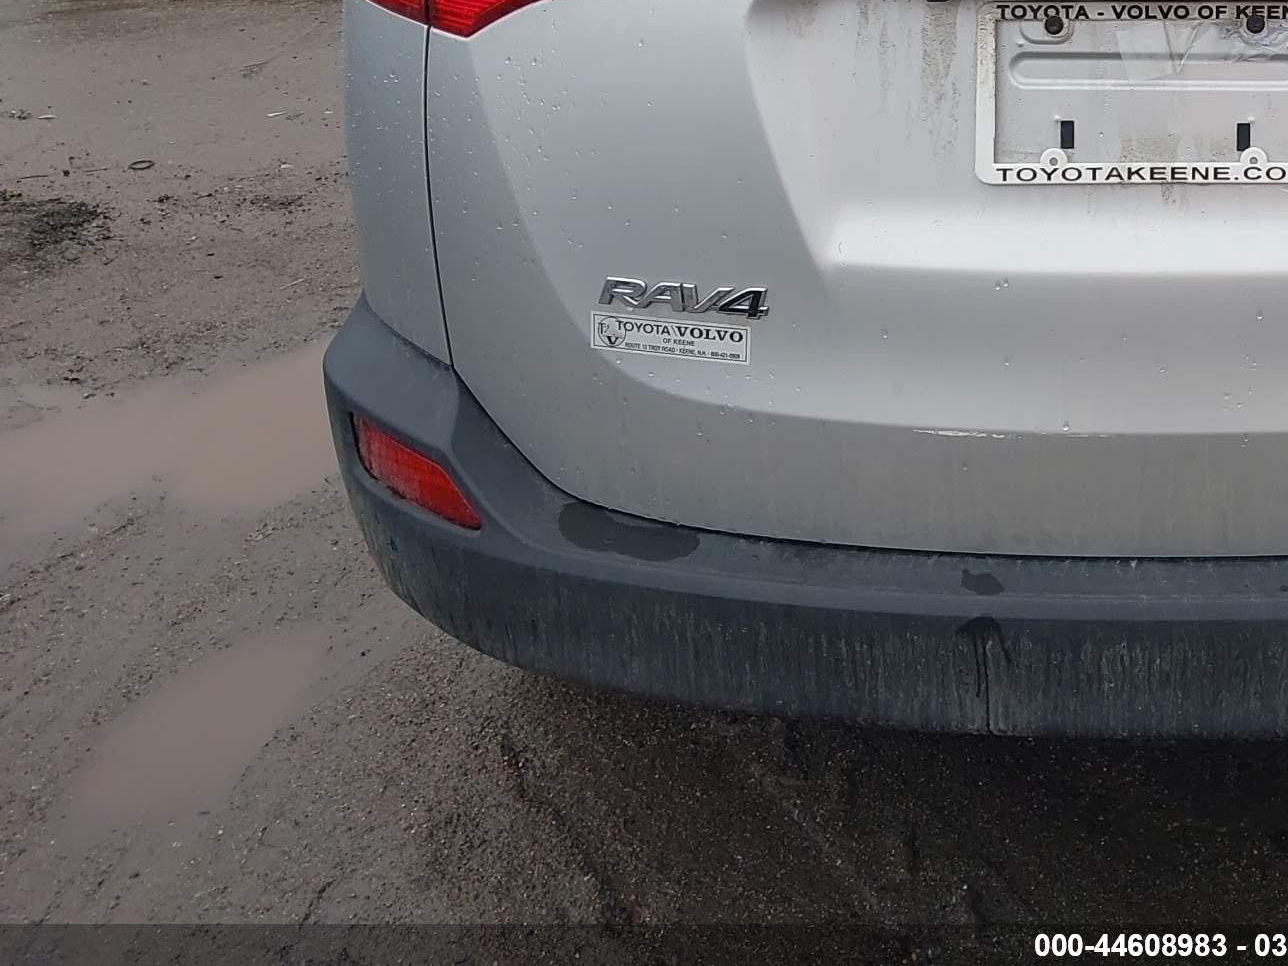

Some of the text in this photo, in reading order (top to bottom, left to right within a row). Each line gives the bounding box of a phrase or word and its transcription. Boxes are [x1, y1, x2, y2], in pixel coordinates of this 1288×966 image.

[996, 5, 1090, 20] TOYOTA
[1111, 5, 1190, 20] VOLVO
[1198, 5, 1228, 20] OF
[598, 276, 770, 320] RAV4
[615, 320, 744, 343] TOYOTA VOLVO
[673, 338, 696, 347] KEENE
